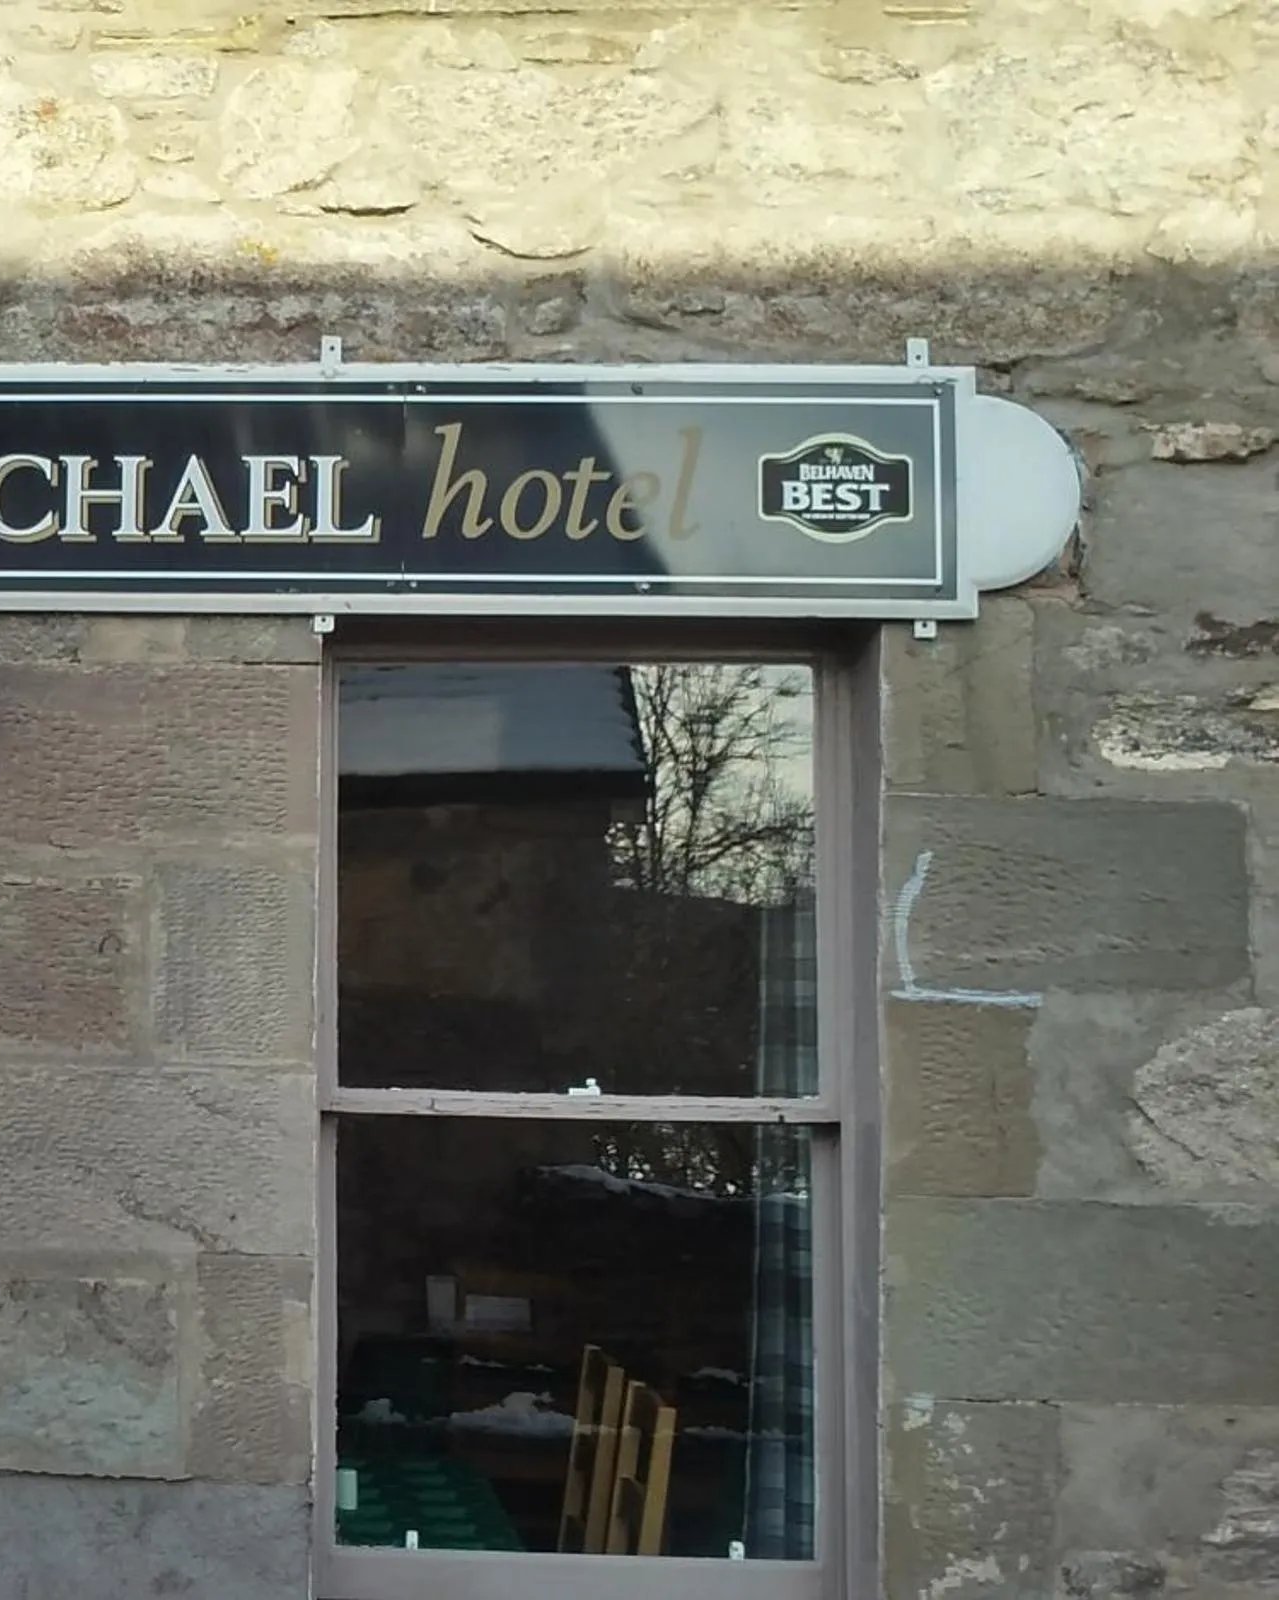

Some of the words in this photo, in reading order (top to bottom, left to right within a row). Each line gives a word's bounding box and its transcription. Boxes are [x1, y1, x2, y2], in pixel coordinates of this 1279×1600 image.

[422, 422, 703, 541] hotel
[799, 463, 874, 481] BELHAVEN
[782, 480, 890, 511] BEST
